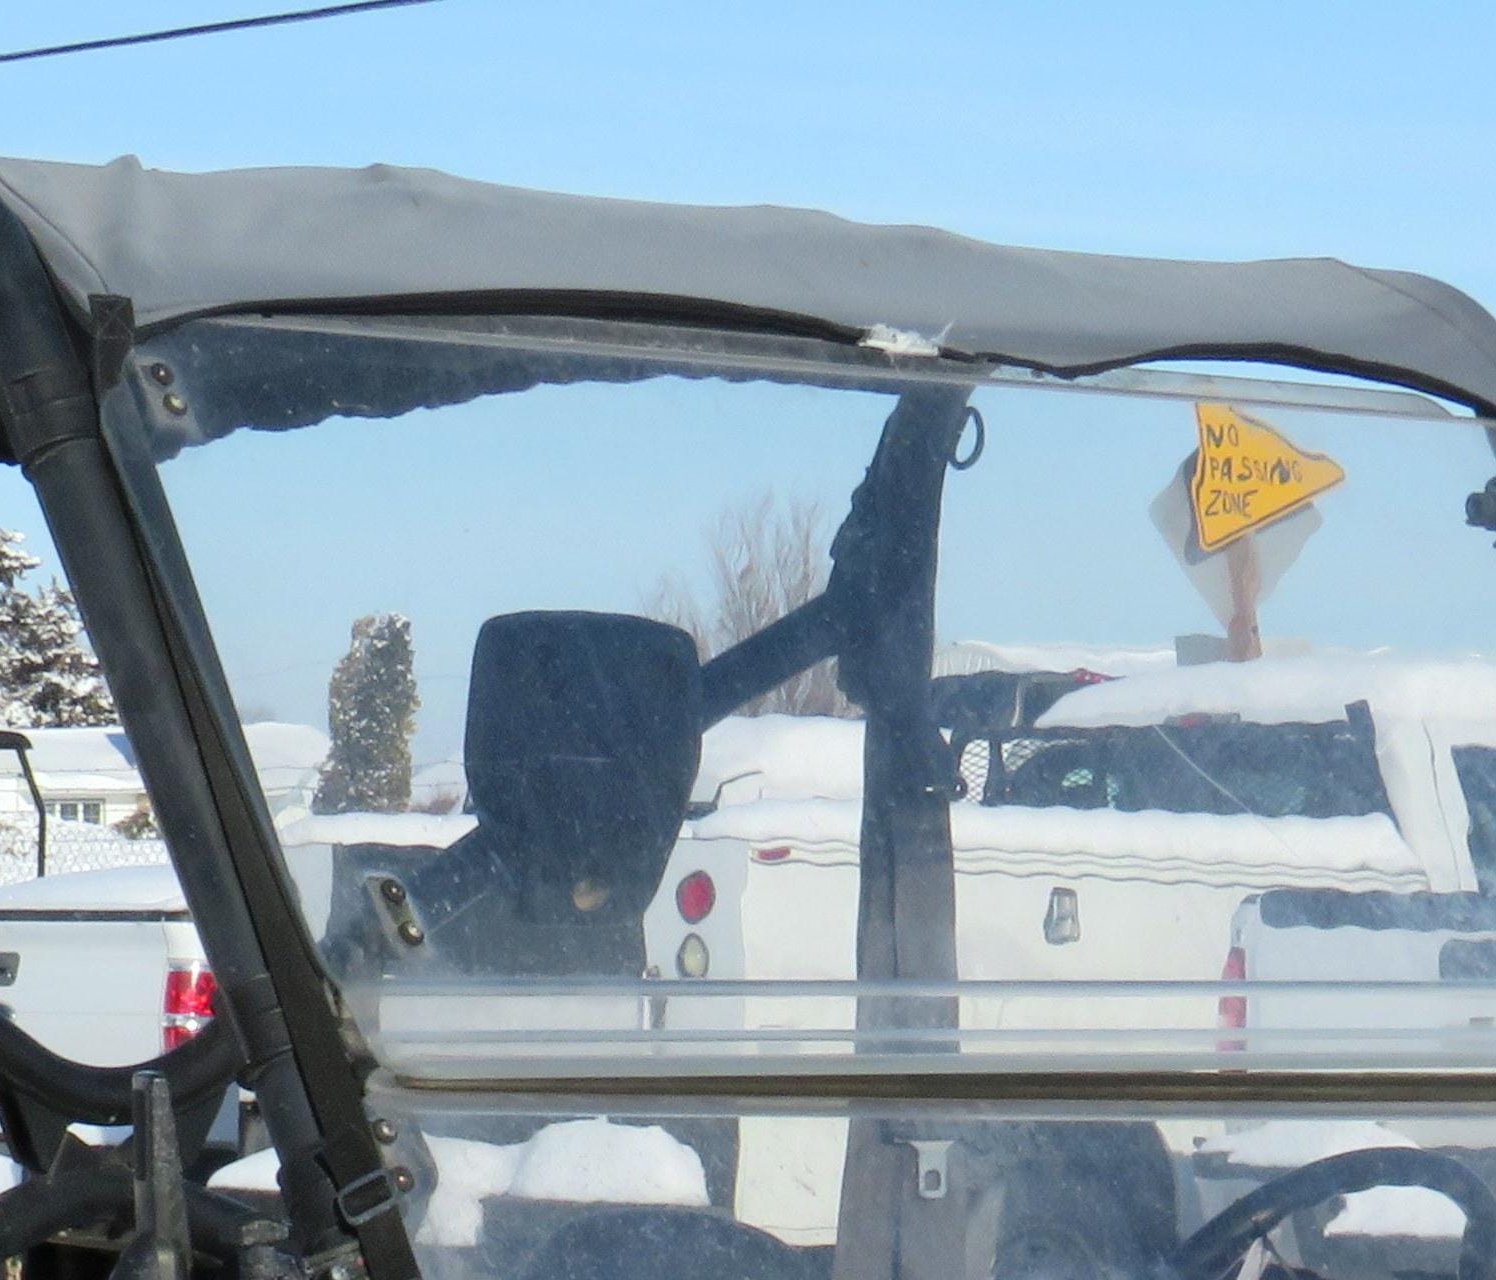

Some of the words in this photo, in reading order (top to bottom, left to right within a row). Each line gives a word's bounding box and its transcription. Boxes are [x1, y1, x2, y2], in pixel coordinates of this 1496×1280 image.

[1206, 423, 1239, 449] NO
[1208, 455, 1303, 485] PASSING
[1205, 489, 1258, 518] ZONE
